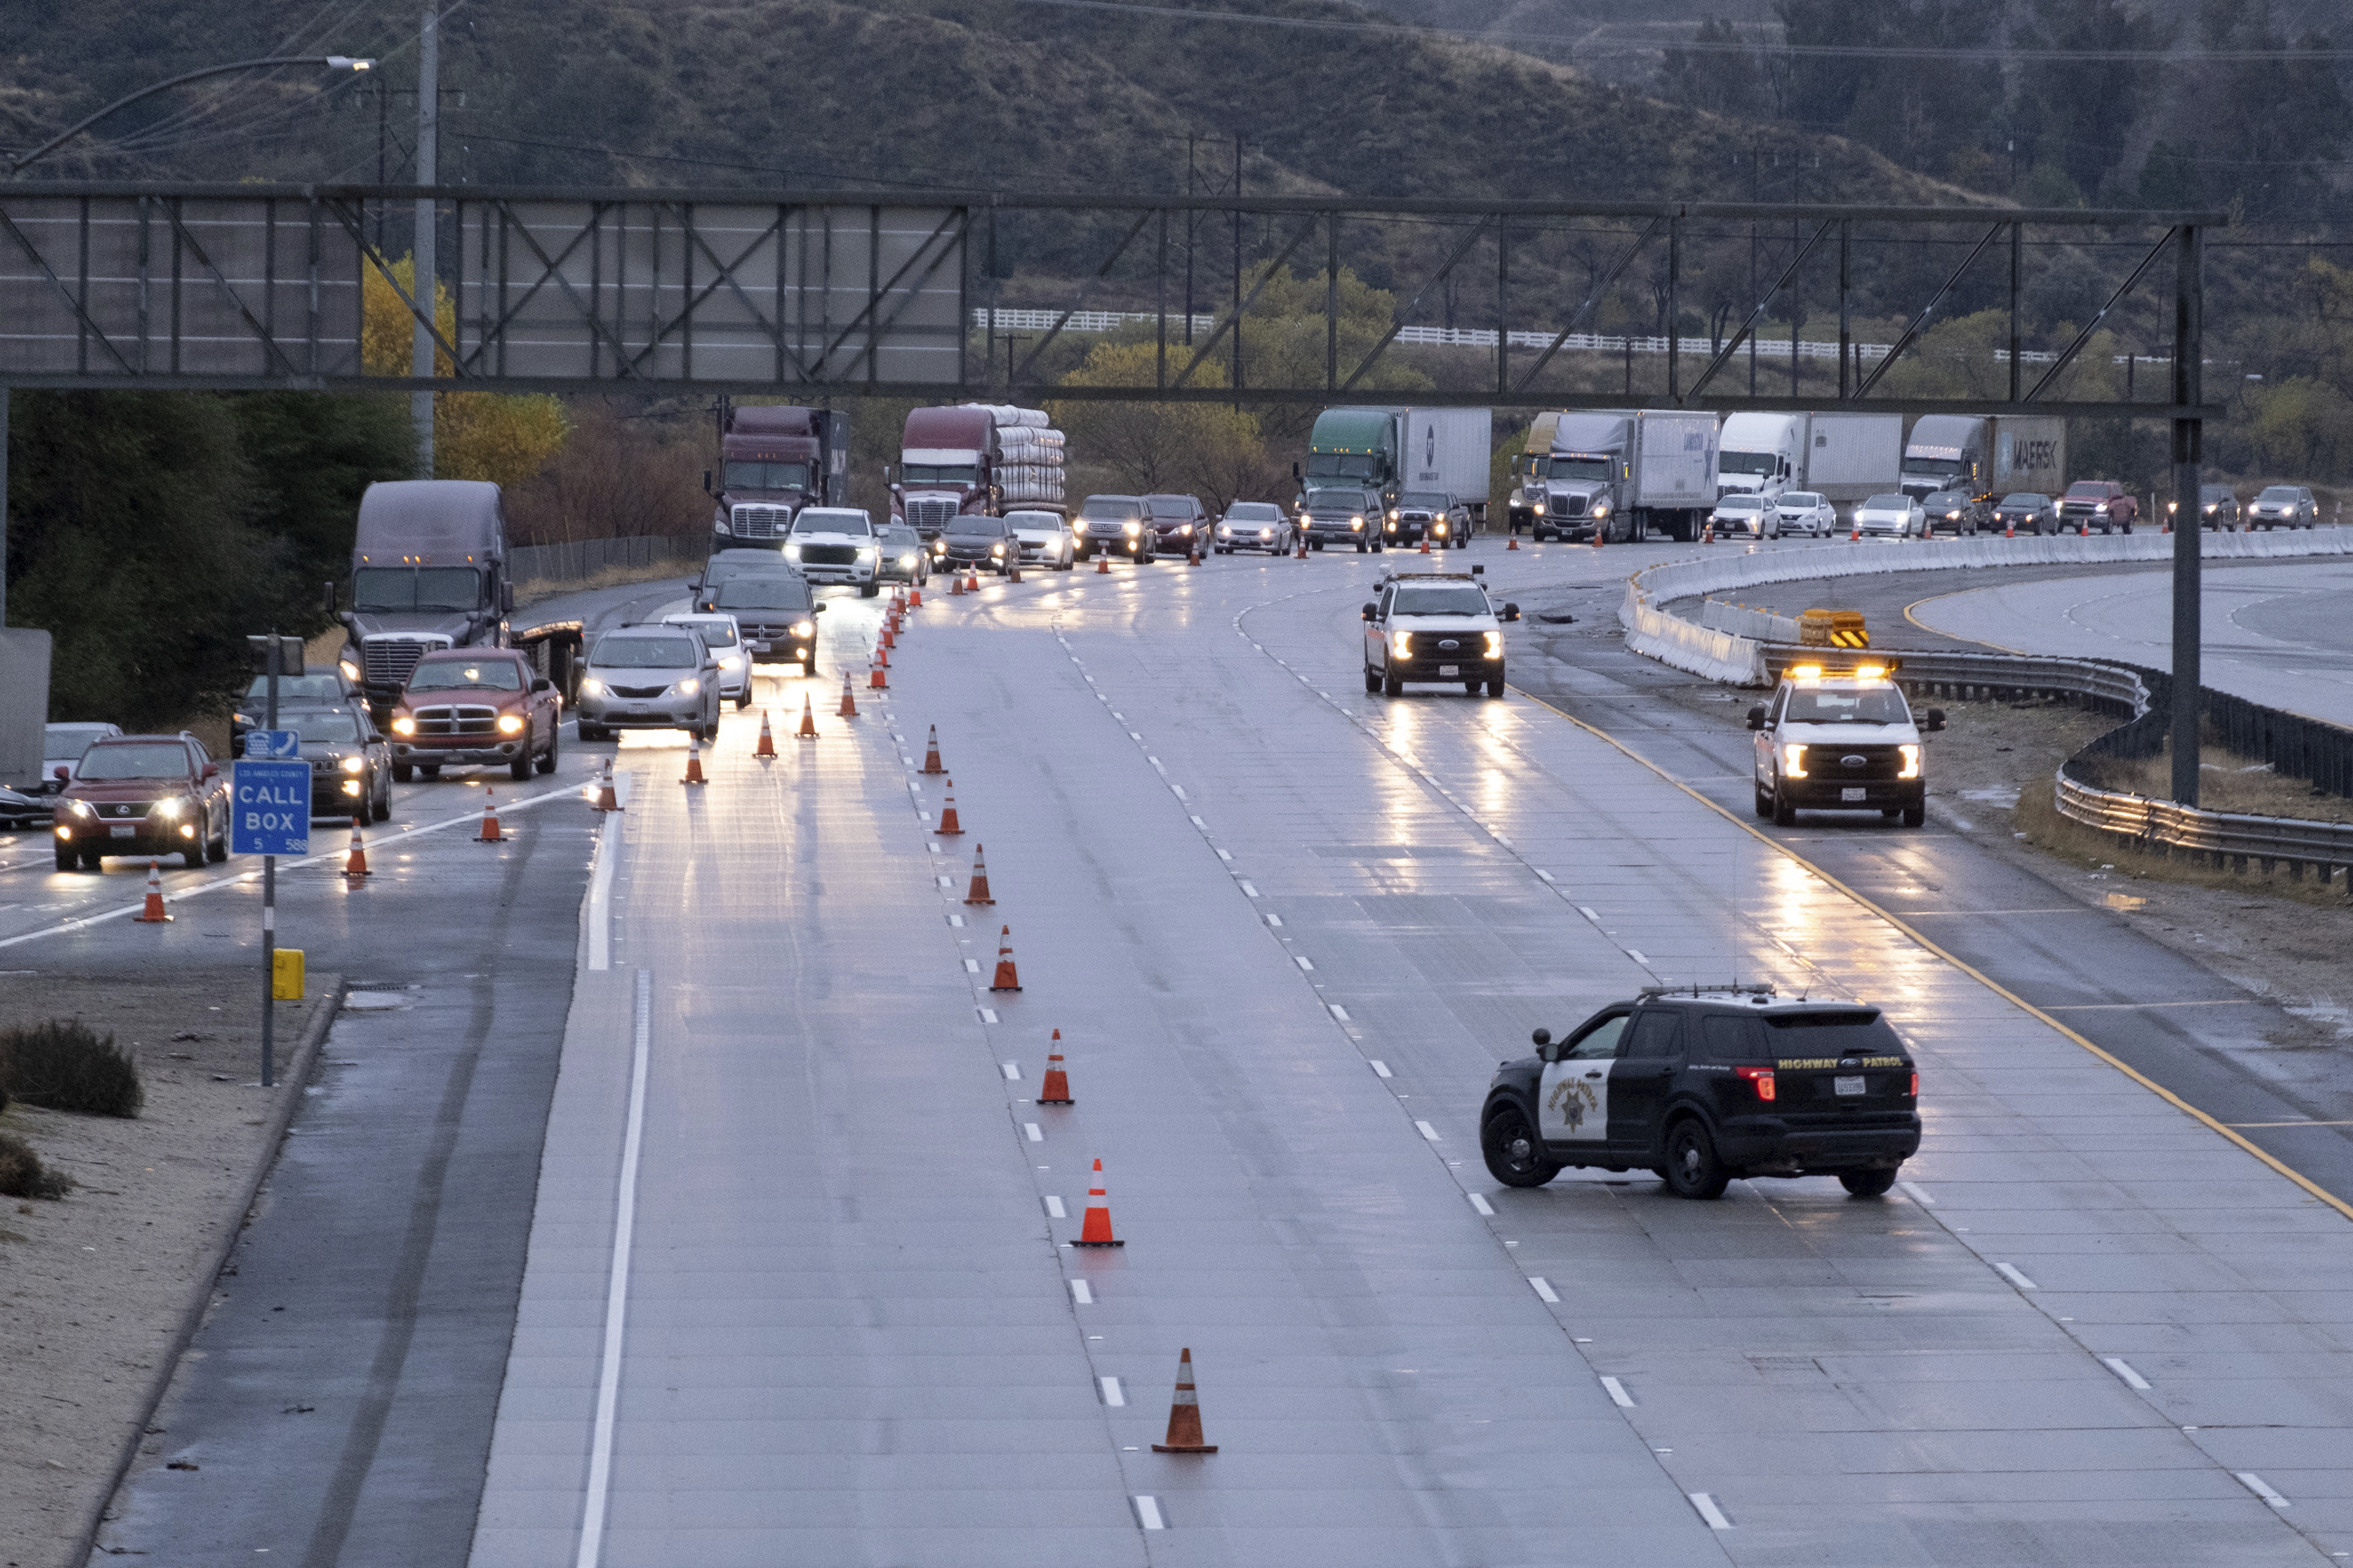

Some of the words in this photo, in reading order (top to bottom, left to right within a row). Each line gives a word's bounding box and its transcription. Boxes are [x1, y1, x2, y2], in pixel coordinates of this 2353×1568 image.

[2014, 440, 2057, 470] MAERSK
[281, 770, 304, 778] COUNTY
[239, 785, 304, 805] CALL
[245, 812, 295, 832] BOX
[253, 838, 264, 851] 5
[285, 838, 308, 852] 588
[1777, 1058, 1838, 1069] HIGHWAY
[1862, 1057, 1903, 1068] PATROL
